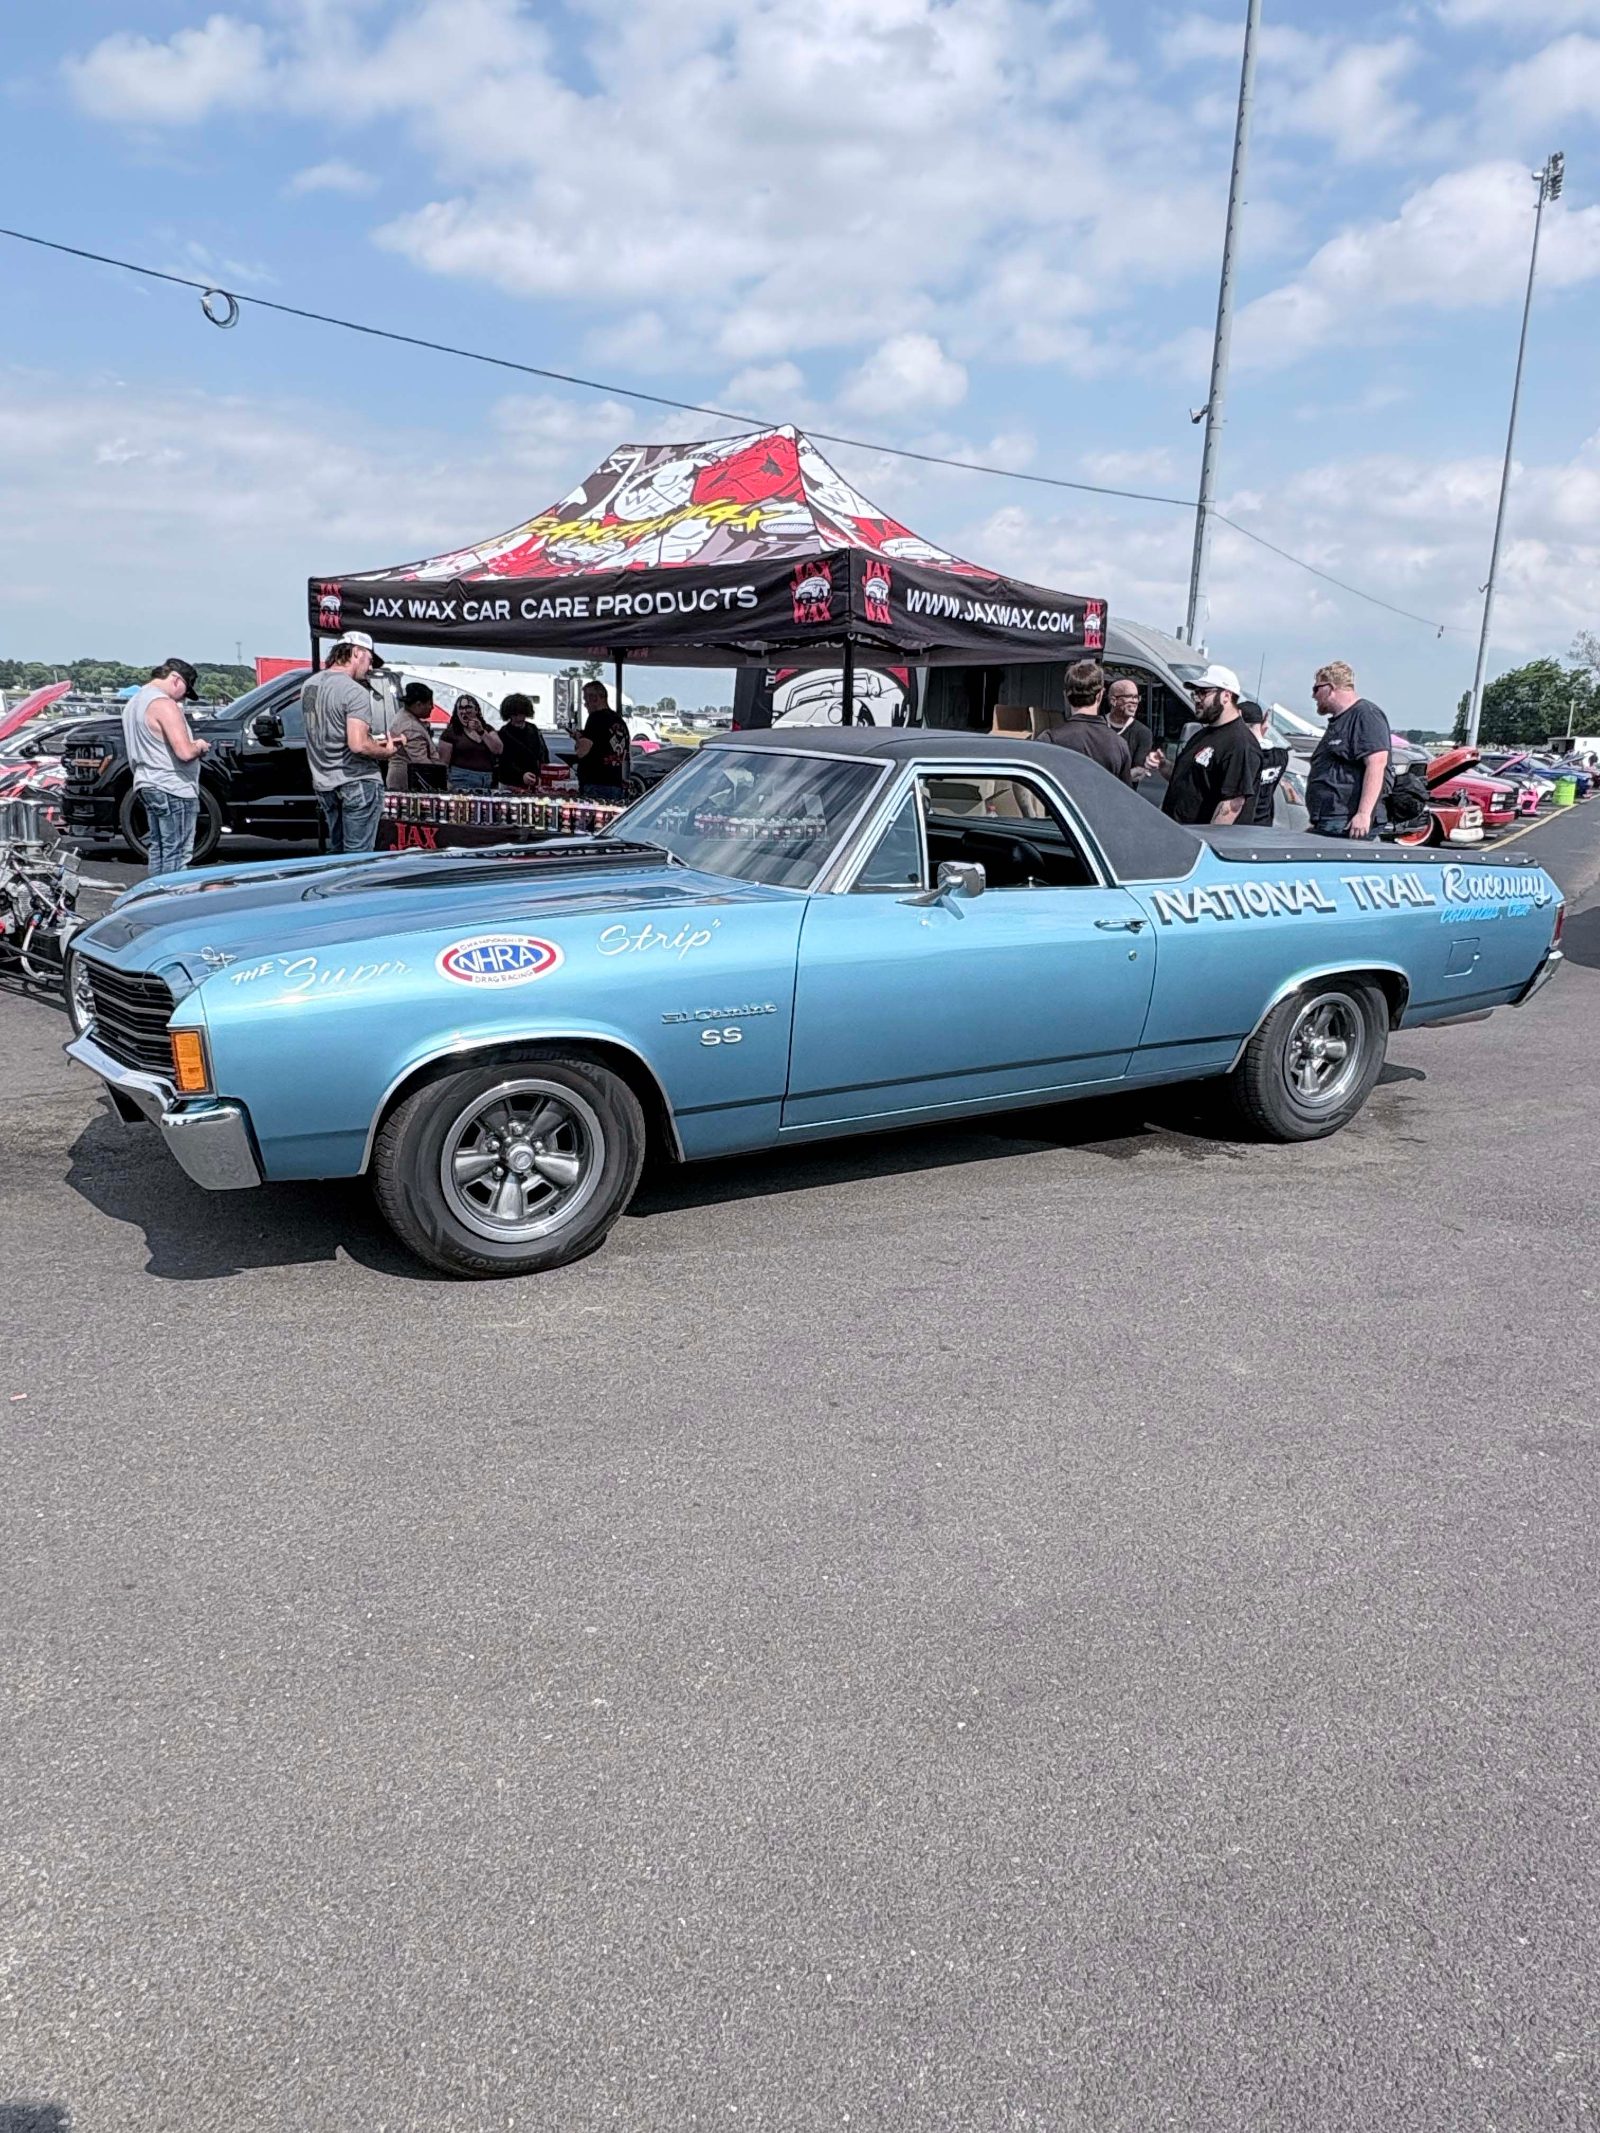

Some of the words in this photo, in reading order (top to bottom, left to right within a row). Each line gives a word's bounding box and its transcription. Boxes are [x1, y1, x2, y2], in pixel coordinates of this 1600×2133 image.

[790, 560, 832, 590] JAX
[862, 559, 892, 588] JAX
[363, 597, 404, 618] JAX
[408, 599, 457, 620] WAX
[463, 599, 511, 621] CAR
[520, 596, 590, 620] CARE
[596, 585, 759, 617] PRODUCTS
[792, 601, 832, 624] WAX
[864, 600, 894, 624] WAX
[906, 588, 1075, 633] WWW.JAXWAX.COM
[390, 821, 440, 850] JAX
[1151, 878, 1338, 925] NATIONAL
[1341, 871, 1436, 910] TRAIL
[1441, 863, 1552, 908] Raceway
[458, 945, 537, 972] NHRA
[230, 960, 276, 986] THE
[474, 973, 501, 983] DRAG
[501, 969, 535, 982] RACING
[699, 1026, 743, 1047] SS
